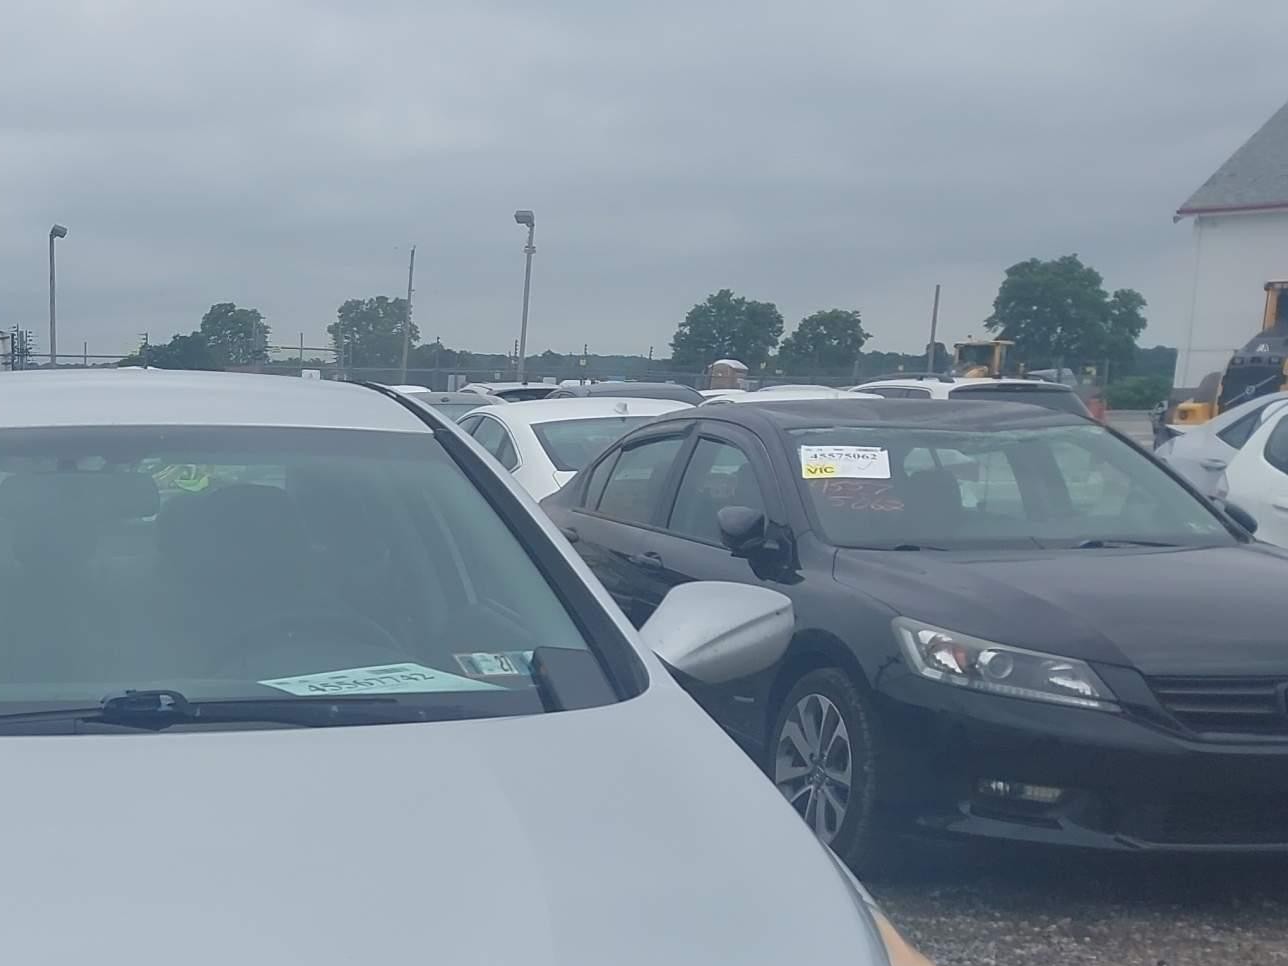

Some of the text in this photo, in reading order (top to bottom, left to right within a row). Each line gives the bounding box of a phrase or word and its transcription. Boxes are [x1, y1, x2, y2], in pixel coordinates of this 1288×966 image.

[810, 452, 878, 461] 45575062
[806, 466, 835, 475] VIC
[307, 672, 436, 693] 45567742
